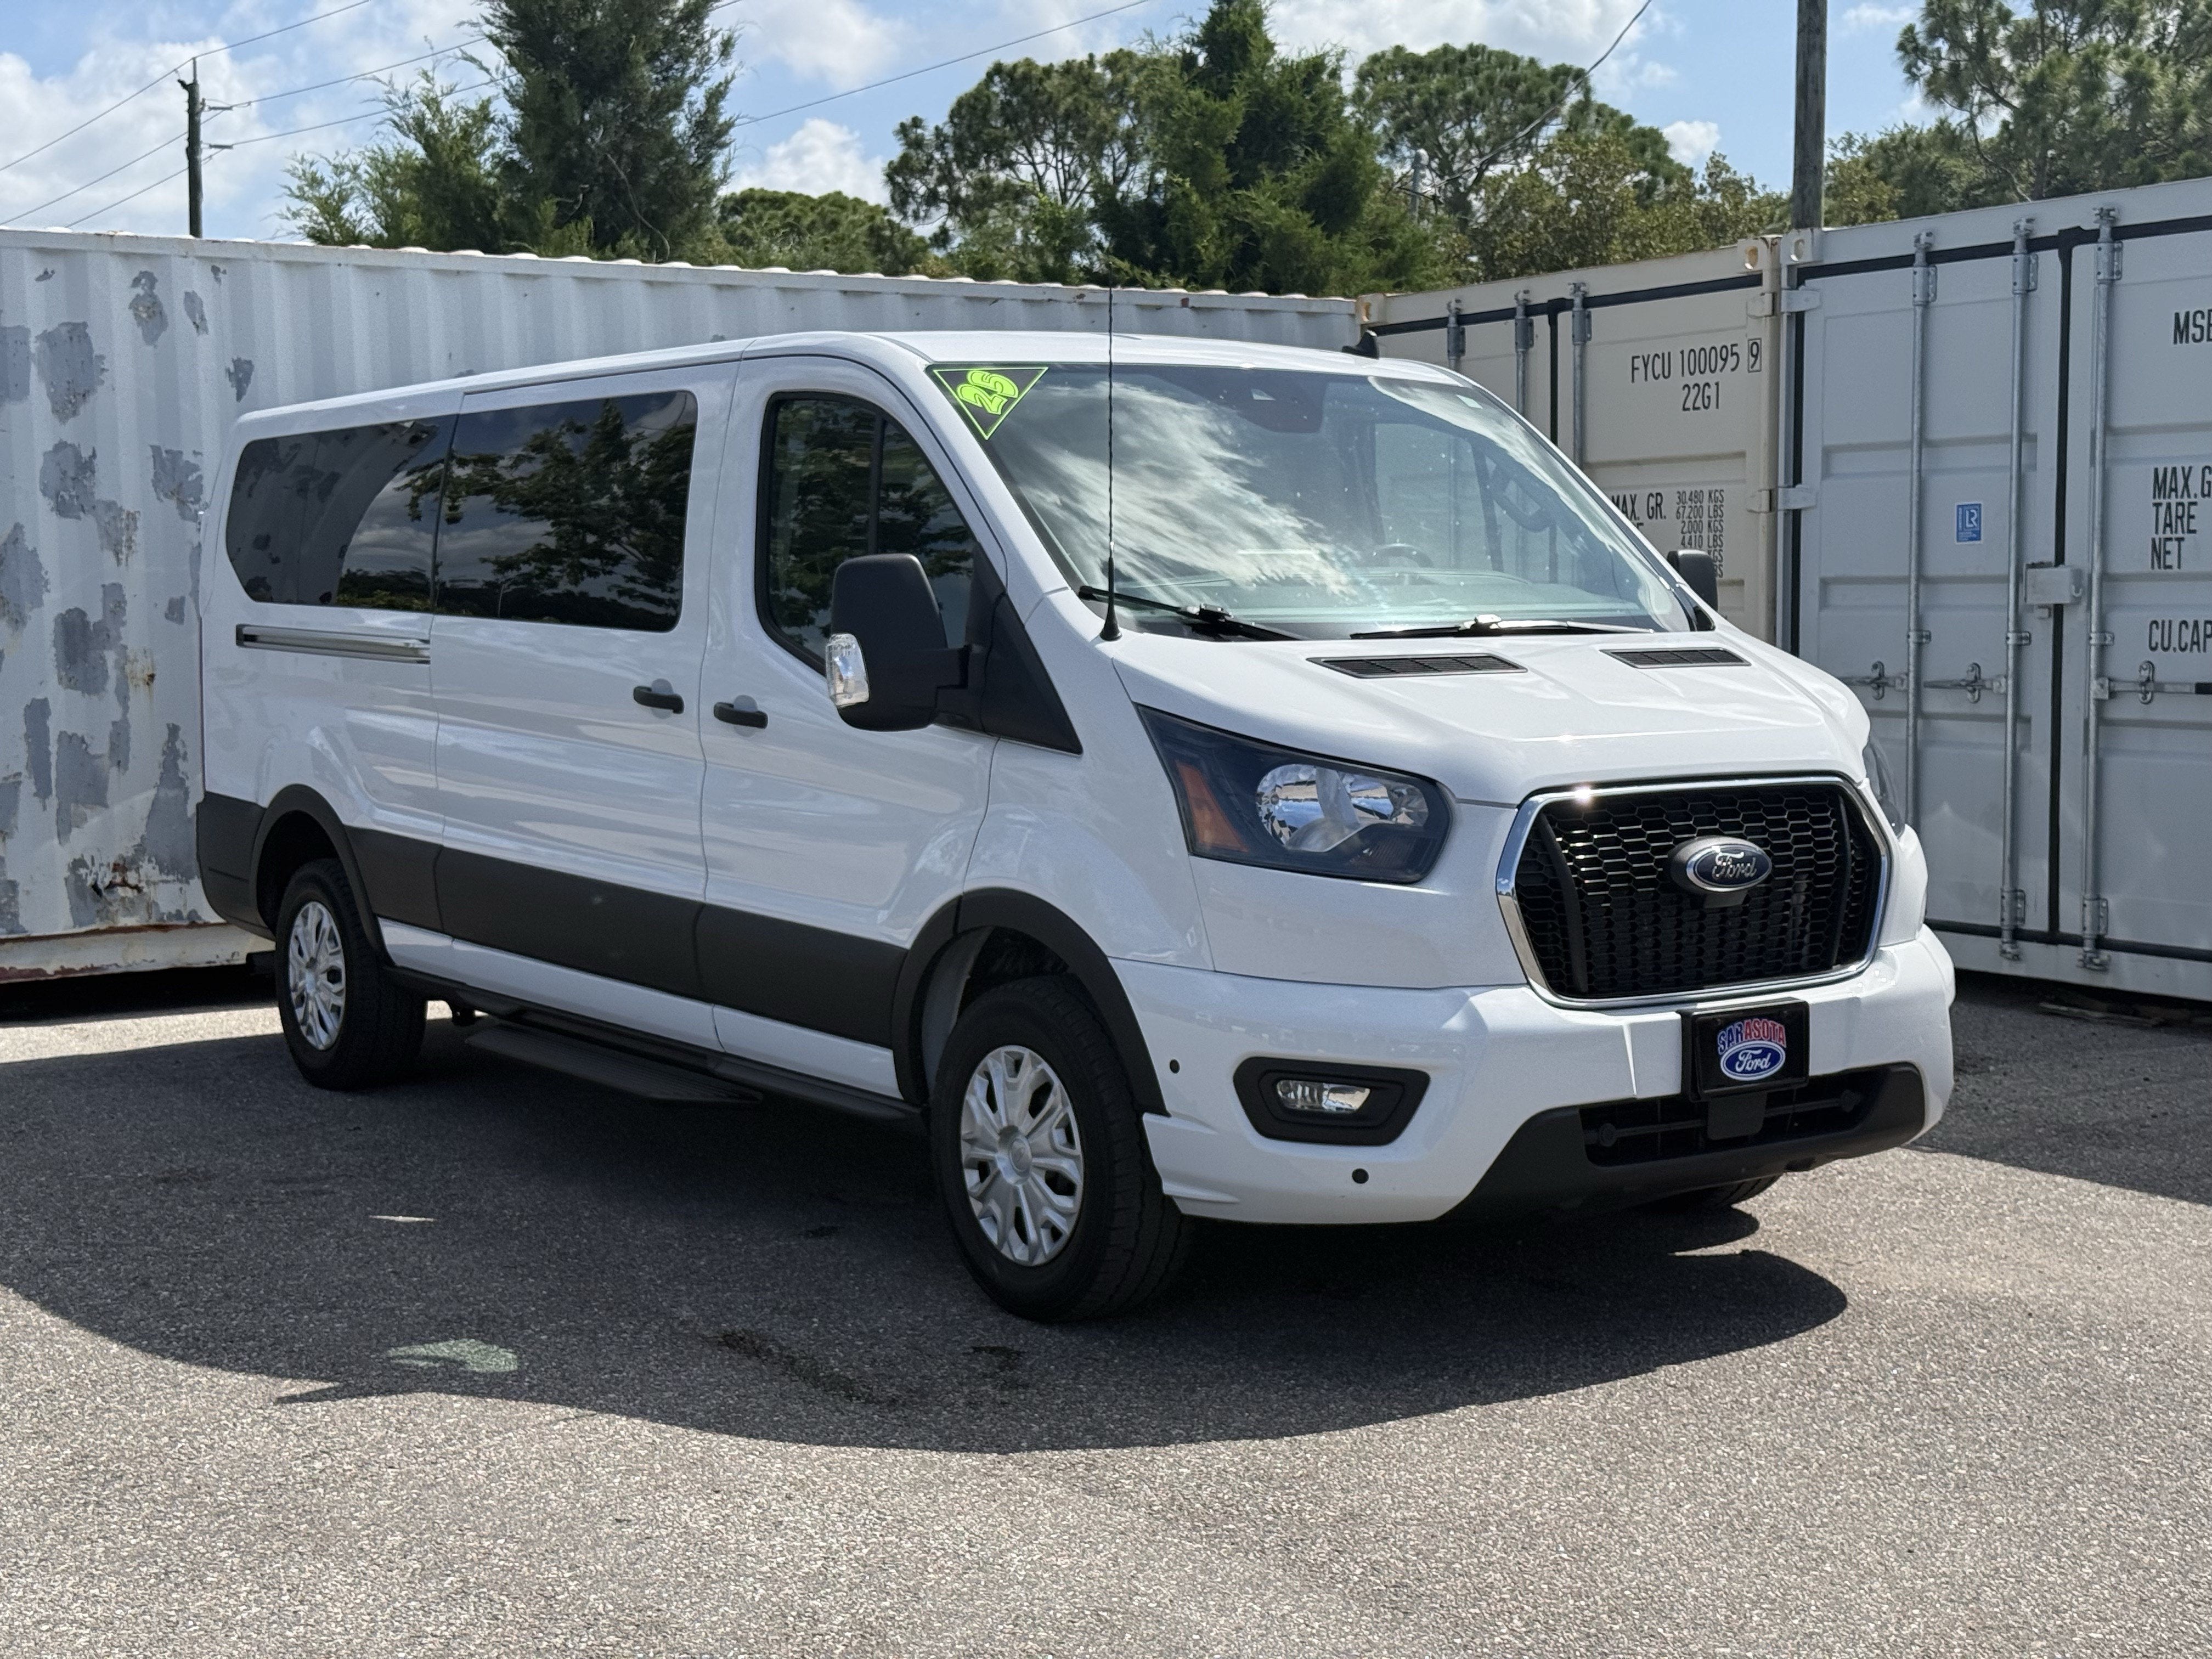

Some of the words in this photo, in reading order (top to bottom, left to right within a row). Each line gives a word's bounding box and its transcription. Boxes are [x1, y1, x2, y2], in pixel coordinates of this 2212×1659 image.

[1631, 351, 1671, 383] FYCU
[1680, 343, 1740, 377] 100095
[1750, 341, 1759, 369] 9
[957, 370, 1019, 415] 25
[1682, 381, 1720, 411] 22G1
[1647, 492, 1667, 520] GR.
[1708, 489, 1724, 504] KGS
[1708, 504, 1724, 518] LBS
[1708, 520, 1724, 533] KGS
[2152, 501, 2198, 534] TARE
[1707, 534, 1724, 548] LBS
[2151, 537, 2185, 570] NET
[2148, 619, 2212, 653] CU.CAP
[1712, 851, 1757, 880] Ford
[1717, 1018, 1787, 1055] SARASOTA
[1735, 1049, 1771, 1073] Ford
